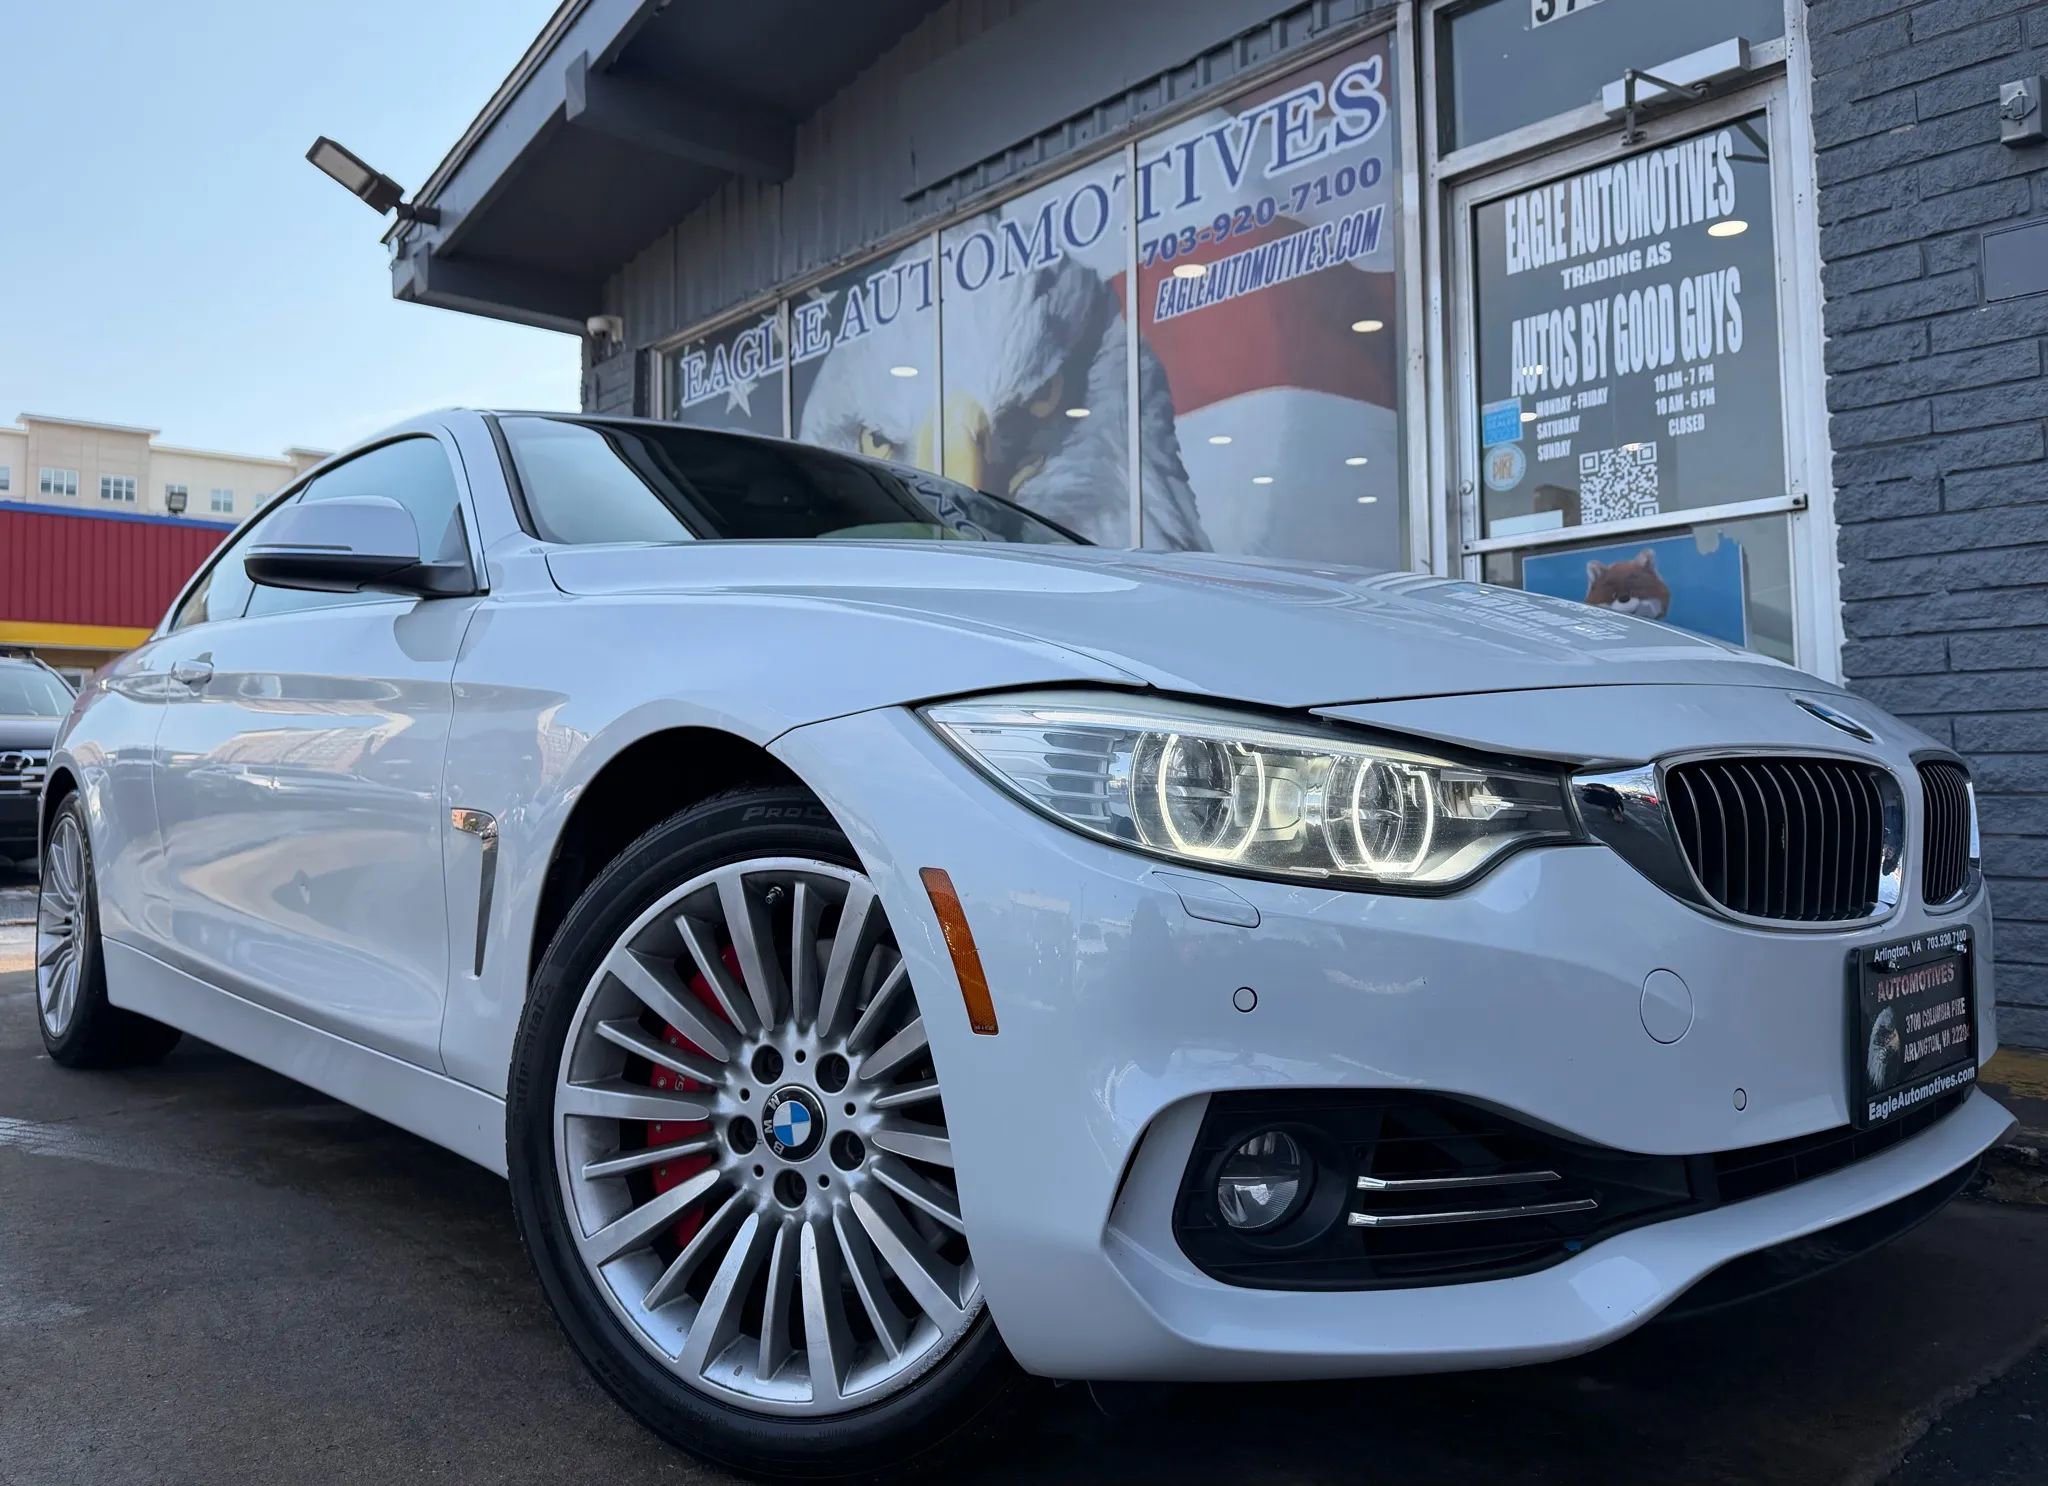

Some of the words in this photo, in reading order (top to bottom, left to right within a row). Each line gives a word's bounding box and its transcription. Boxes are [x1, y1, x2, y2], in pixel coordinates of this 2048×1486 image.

[1143, 157, 1382, 268] 703-920-7100
[1505, 183, 1567, 276] EAGLE
[1570, 130, 1736, 258] AUTOMOTIVES
[681, 301, 831, 406] EAGLE
[835, 55, 1386, 343] AUTOMOTIVES
[1154, 204, 1386, 322] EAGLEAUTOMOTIVES.COM
[1560, 249, 1642, 290] TRADING
[1645, 241, 1673, 269] AS
[1511, 305, 1578, 397] AUTOS
[1580, 297, 1609, 381] BY
[1613, 283, 1676, 377] GOOD
[1679, 266, 1744, 363] GUYS
[1654, 374, 1666, 393] 10
[1667, 370, 1683, 391] AM
[1688, 368, 1695, 385] 7
[1698, 364, 1715, 384] PM
[1536, 394, 1572, 418] MONDAY
[1577, 387, 1609, 410] FRIDAY
[1655, 397, 1667, 416] 10
[1668, 393, 1684, 413] AM
[1690, 391, 1698, 409] 6
[1699, 387, 1716, 406] PM
[1536, 415, 1580, 441] SATURDAY
[1668, 413, 1706, 437] CLOSED
[1537, 439, 1571, 462] SUNDAY
[1874, 945, 1910, 962] Arlington,
[1911, 939, 1922, 953] VA
[1877, 962, 1955, 1002] AUTOMOTIVES
[1868, 1066, 1975, 1120] EagleAutomotives.com
[764, 1094, 785, 1155] BMW
